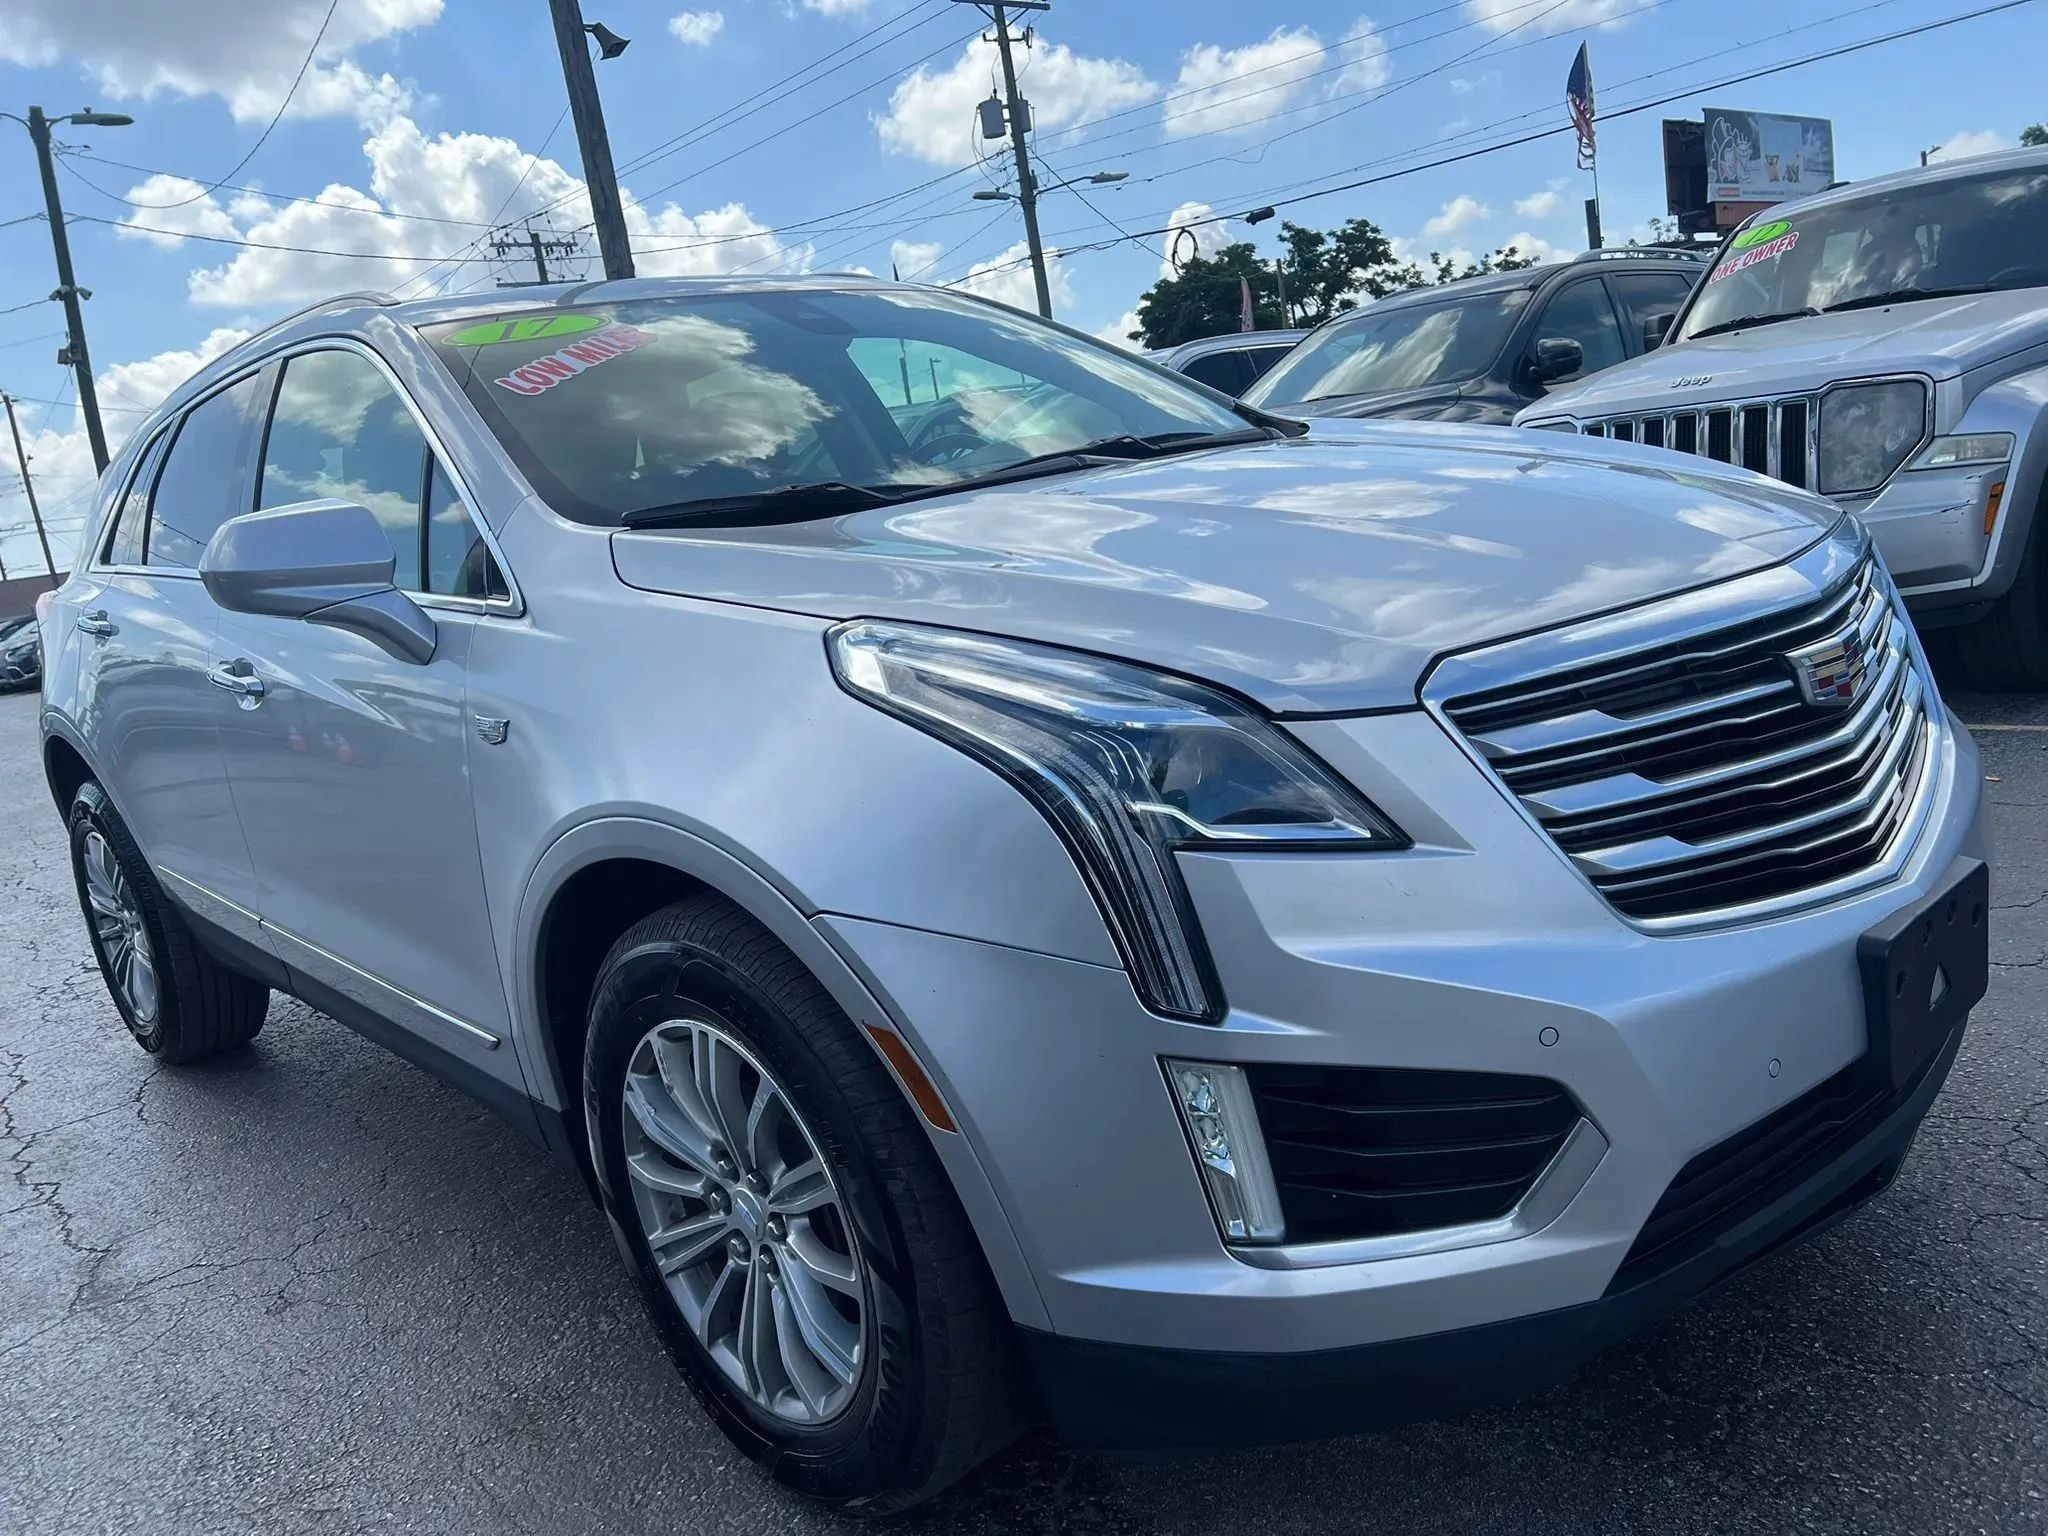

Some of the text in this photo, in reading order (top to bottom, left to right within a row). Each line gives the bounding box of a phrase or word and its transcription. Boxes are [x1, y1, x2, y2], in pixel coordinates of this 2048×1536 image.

[1743, 224, 1778, 246] 12
[1711, 233, 1797, 282] ONE OWNER
[497, 316, 560, 341] 17
[498, 328, 656, 394] LOW MIL
[1670, 375, 1712, 389] Jeep
